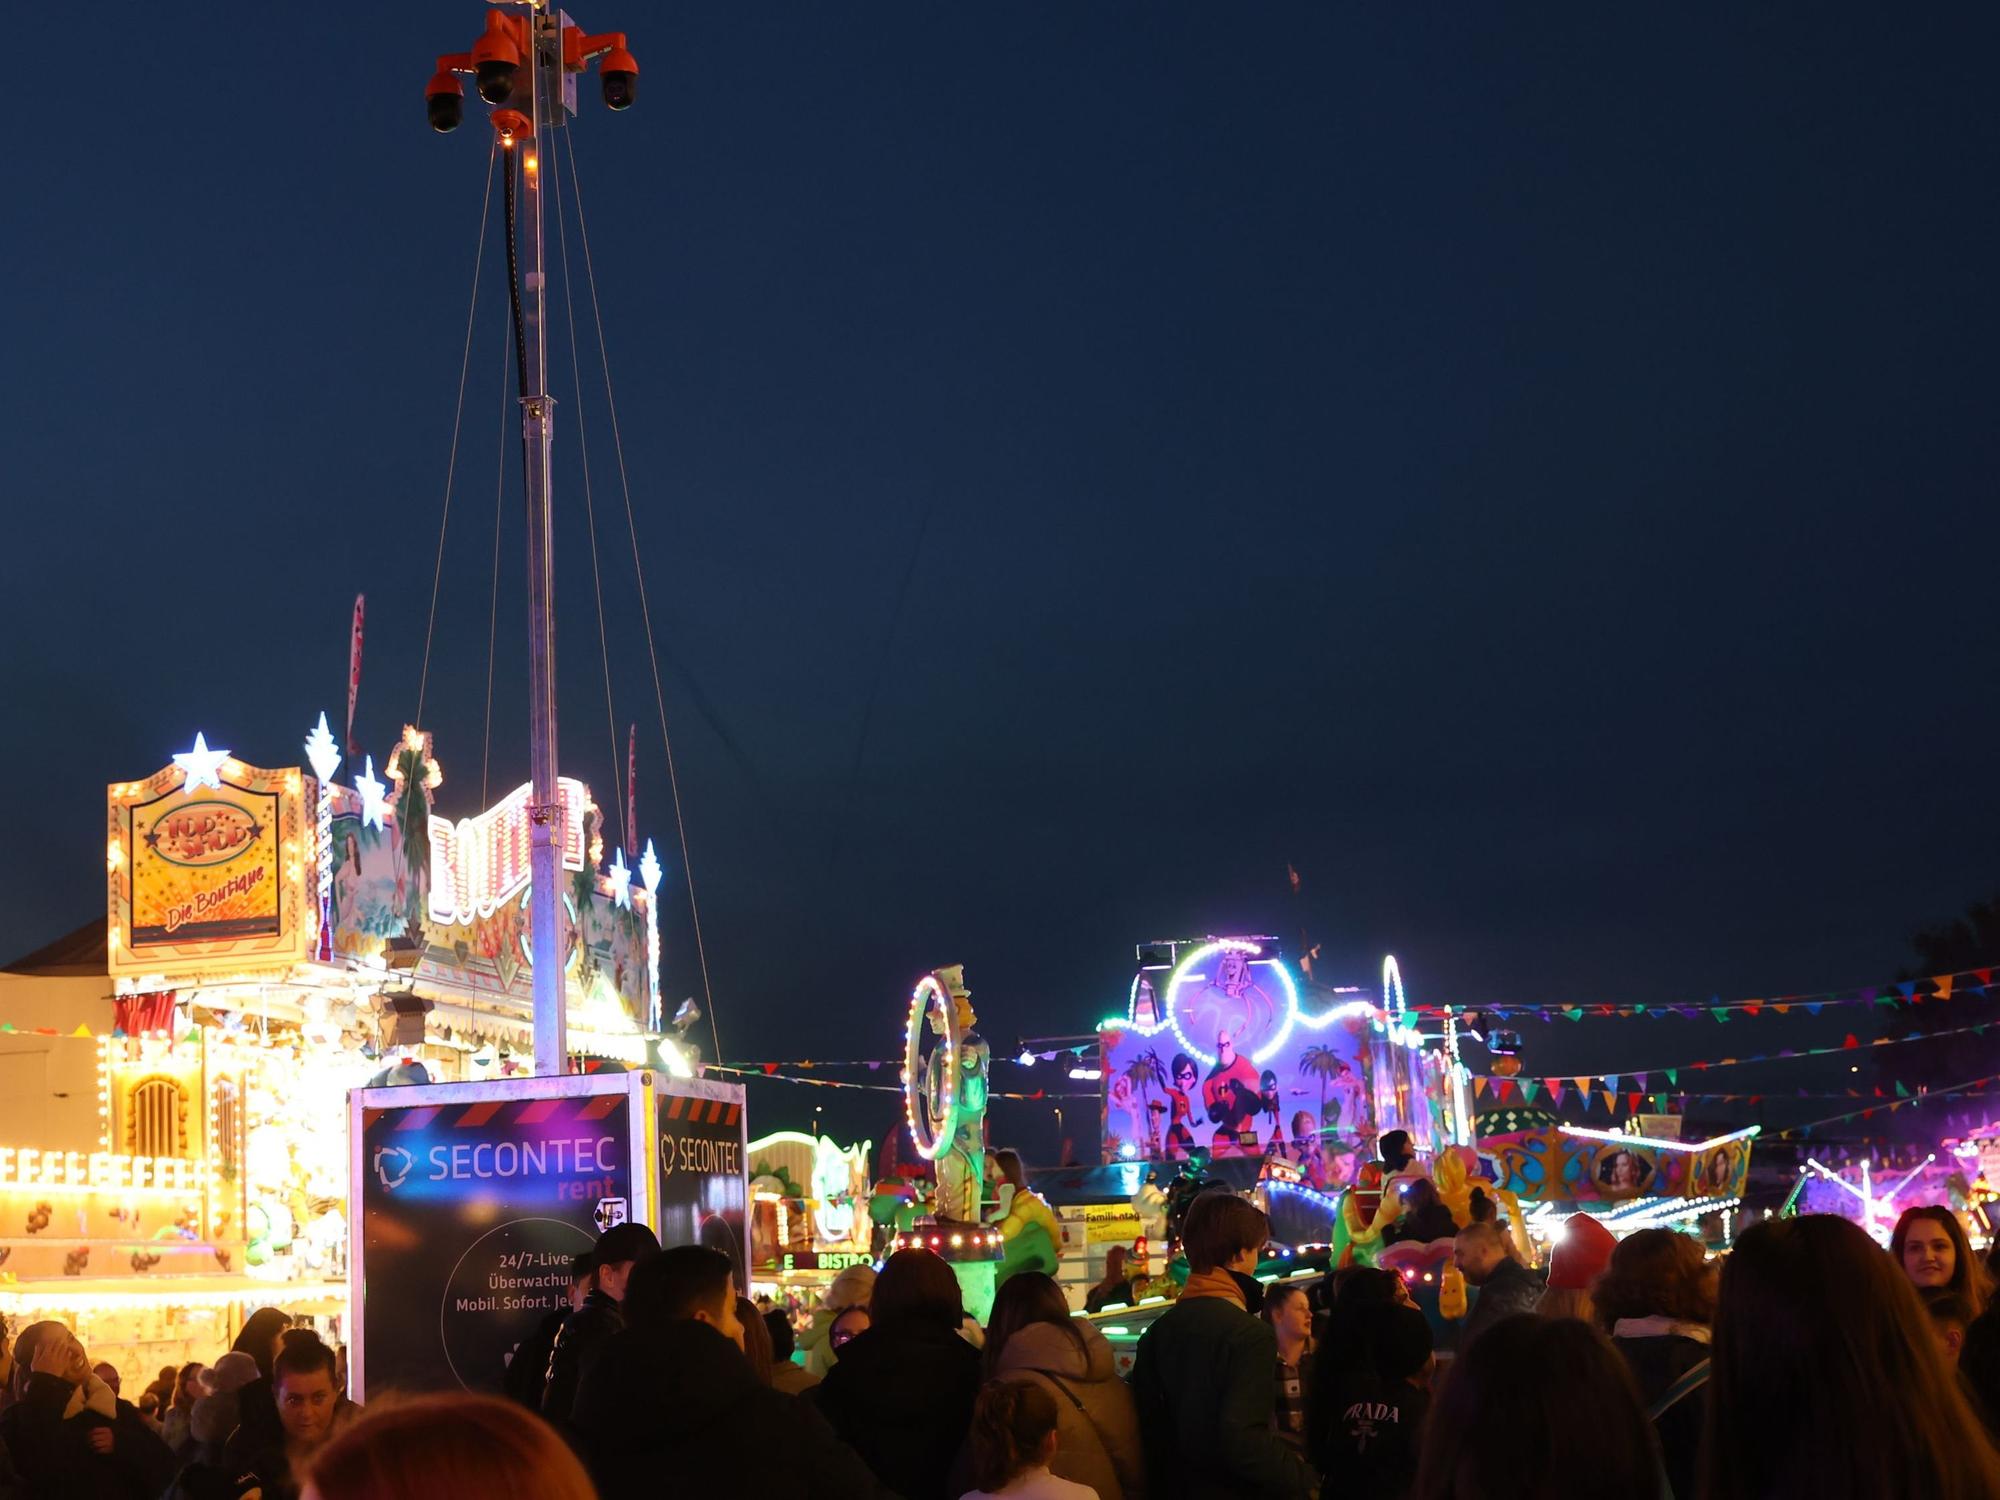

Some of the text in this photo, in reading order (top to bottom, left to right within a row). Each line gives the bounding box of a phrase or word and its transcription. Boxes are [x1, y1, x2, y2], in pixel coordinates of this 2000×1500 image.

[168, 816, 216, 839] TOP
[168, 866, 264, 929] Die Boutique
[429, 1136, 616, 1181] SECONTEC
[680, 1137, 740, 1175] SECONTEC
[557, 1175, 615, 1201] rent
[499, 1251, 576, 1270] 24/7-Live-
[818, 1253, 874, 1270] BISTRO
[489, 1273, 574, 1290] Überwachu
[456, 1297, 500, 1312] Mobil.
[503, 1295, 551, 1310] Sofort.
